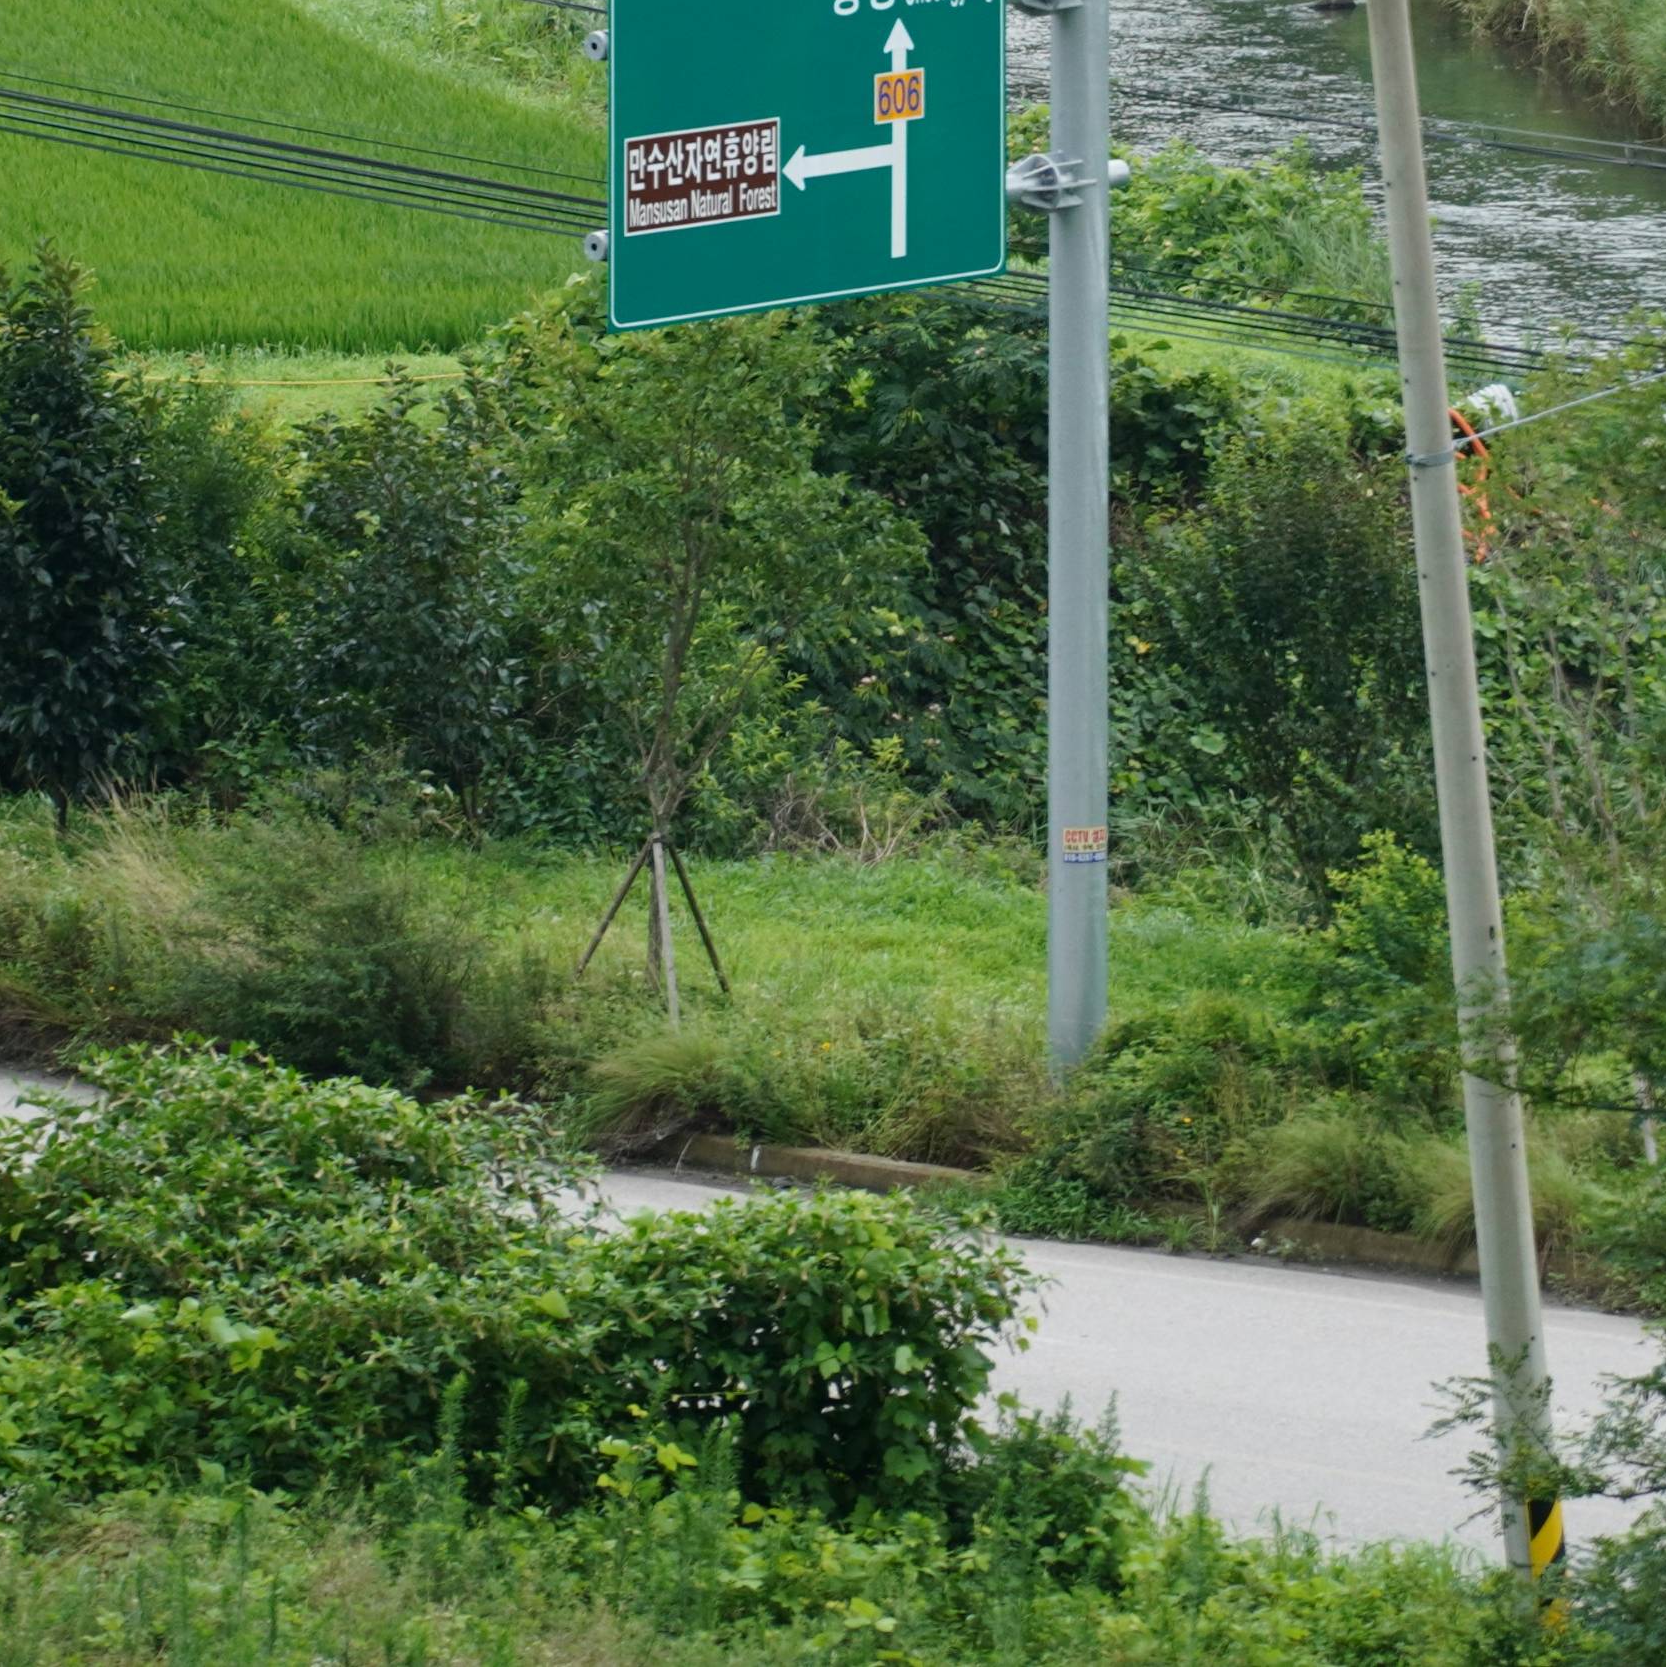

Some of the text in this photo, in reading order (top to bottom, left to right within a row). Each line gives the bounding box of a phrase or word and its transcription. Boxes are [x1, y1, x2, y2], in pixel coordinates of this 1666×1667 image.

[878, 75, 920, 115] 606
[628, 125, 777, 191] 만수산자연휴양림
[629, 180, 776, 228] Mansusan Natural Forest
[1064, 829, 1089, 843] CCTV
